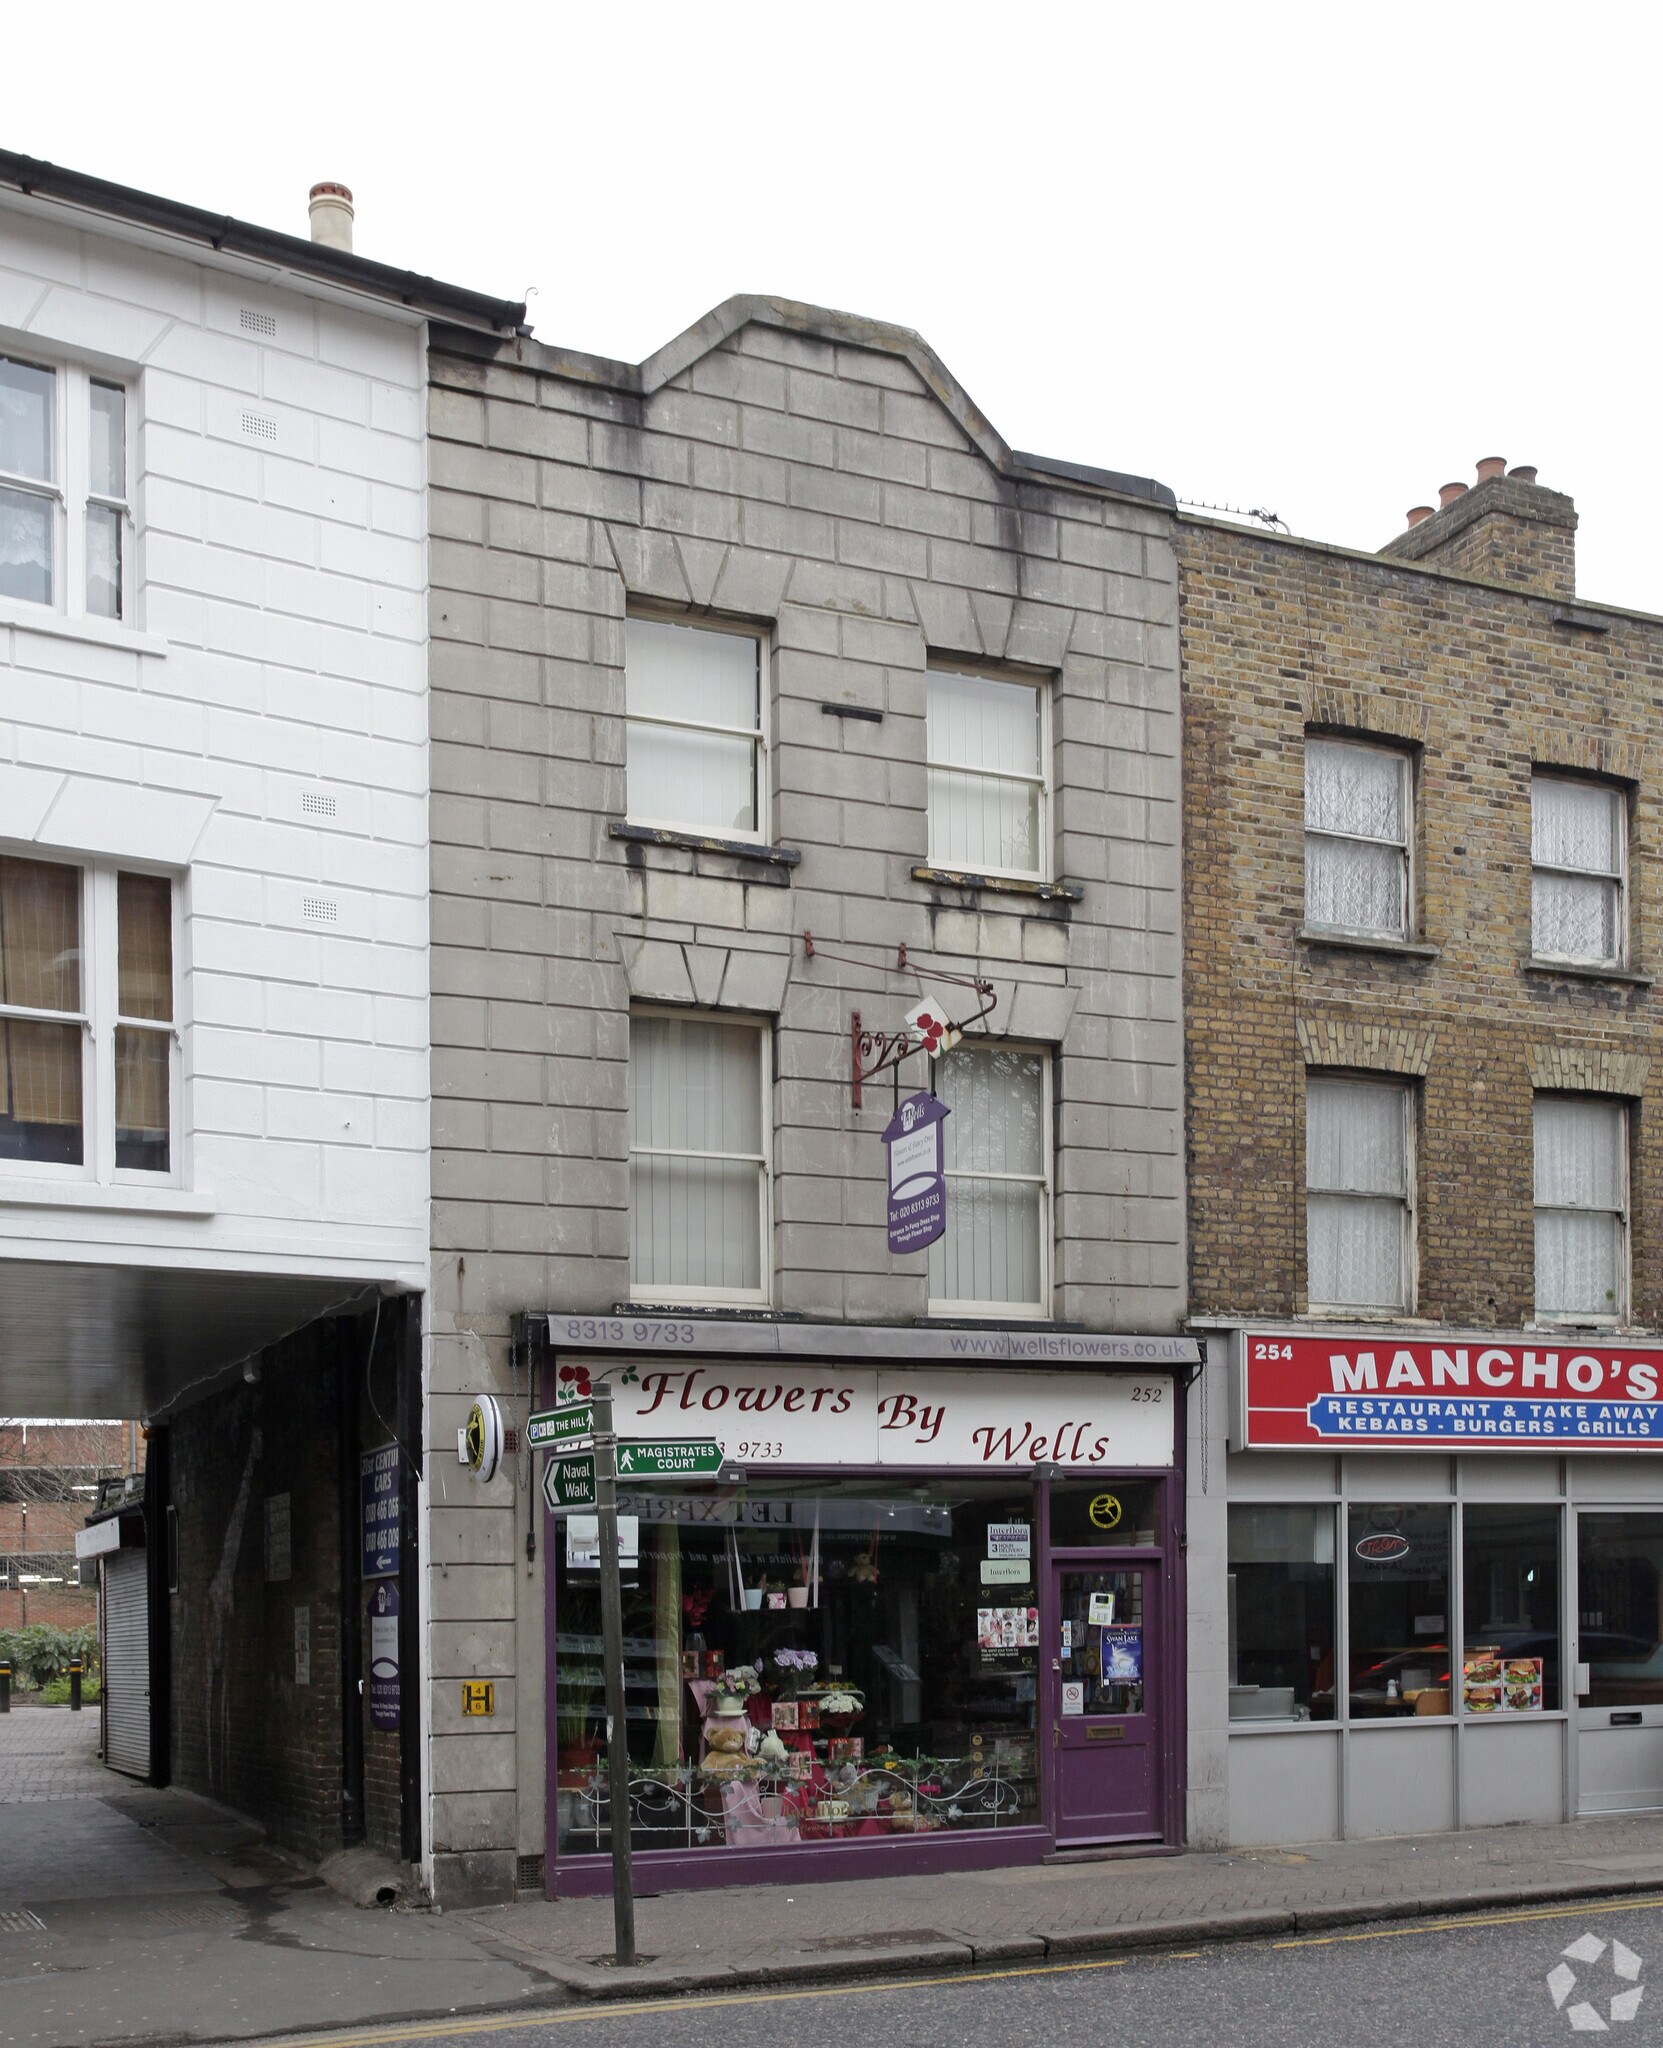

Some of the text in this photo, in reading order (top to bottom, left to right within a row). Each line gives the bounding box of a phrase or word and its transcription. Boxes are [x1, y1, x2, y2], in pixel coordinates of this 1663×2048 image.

[890, 1193, 940, 1222] Tel: 020 8313 9733
[889, 1213, 940, 1238] Entrance To Fancy Dress Shop
[897, 1224, 933, 1243] Through Flower Shop
[568, 1320, 695, 1344] 8313 9733
[1255, 1344, 1293, 1360] 254
[1329, 1349, 1659, 1400] MANCHO'S
[636, 1369, 855, 1415] Flowers
[1131, 1387, 1162, 1403] 252
[1328, 1401, 1658, 1420] RESTAURANT & TAKE AWAY
[556, 1416, 586, 1431] THE HILL
[878, 1393, 1110, 1462] By Wells
[1338, 1417, 1428, 1431] KEBABS
[1453, 1419, 1555, 1434] BURGERS
[1578, 1421, 1650, 1435] GRILLS
[637, 1446, 715, 1458] MAGISTRATES
[737, 1441, 783, 1458] 9733
[562, 1462, 590, 1479] Naval
[657, 1459, 696, 1469] COURT
[374, 1471, 392, 1493] CARS
[565, 1482, 589, 1498] Walk
[990, 1526, 1028, 1534] Interflora
[992, 1544, 998, 1553] 3
[1106, 1634, 1123, 1645] SWAN
[1123, 1633, 1138, 1644] LAKE
[467, 1685, 490, 1712] H
[475, 1687, 481, 1695] 4
[475, 1702, 482, 1710] 6
